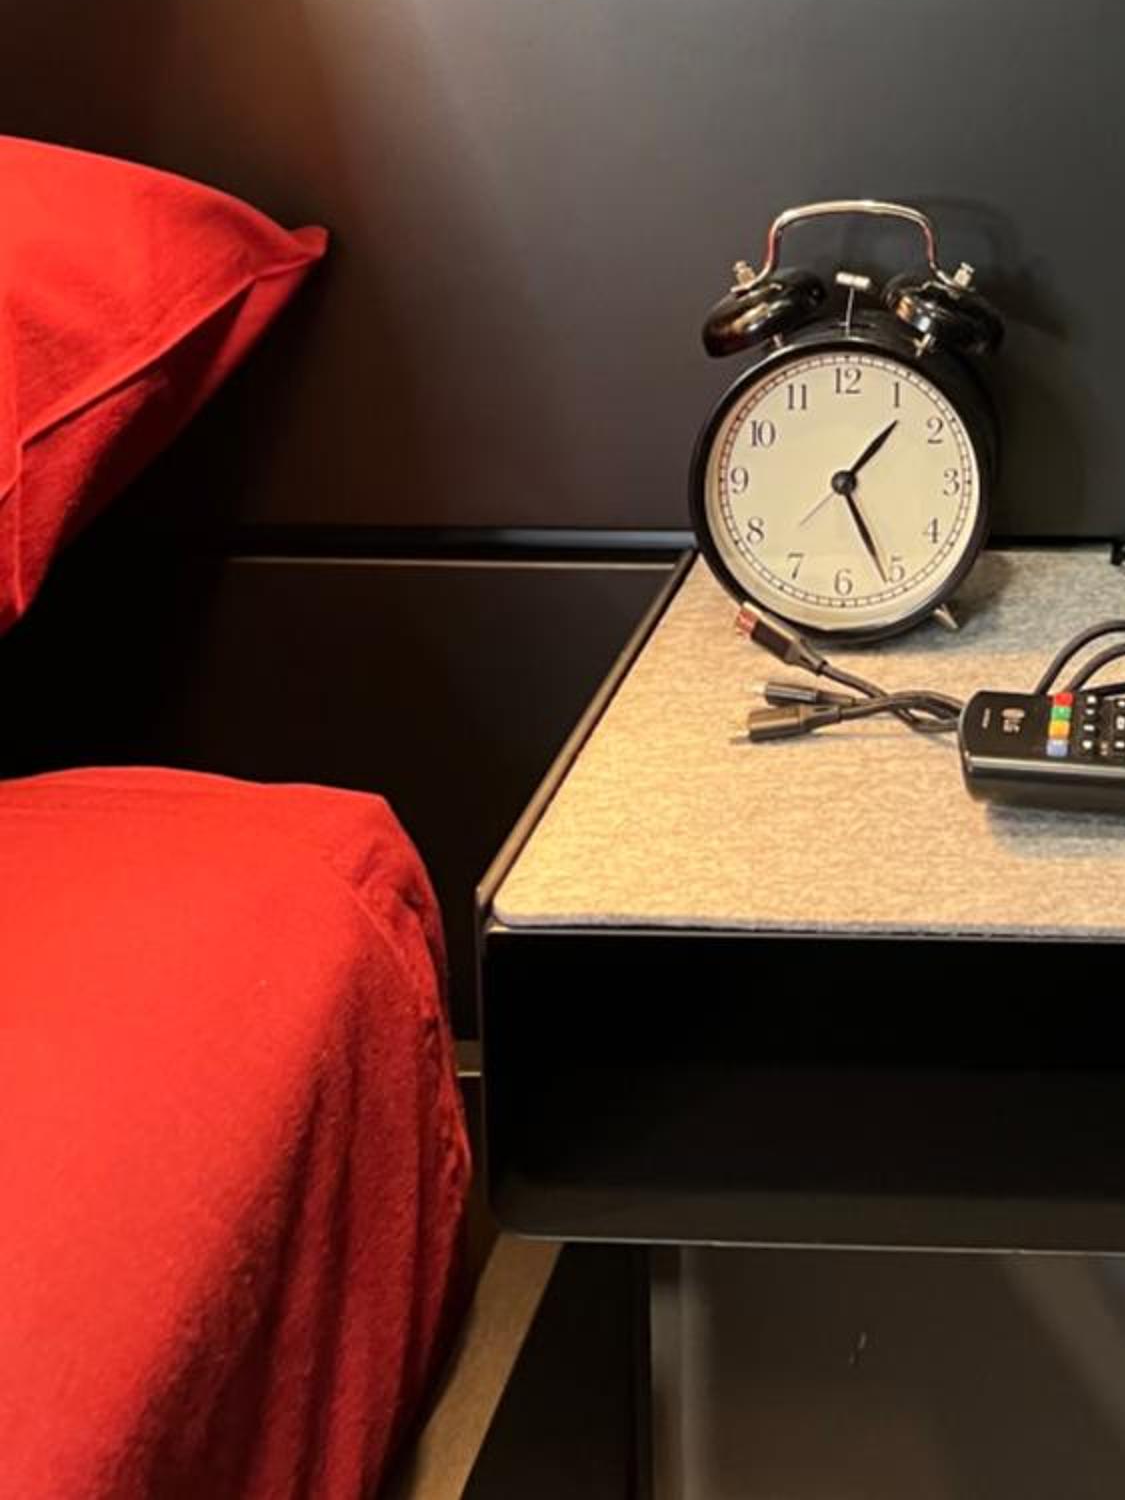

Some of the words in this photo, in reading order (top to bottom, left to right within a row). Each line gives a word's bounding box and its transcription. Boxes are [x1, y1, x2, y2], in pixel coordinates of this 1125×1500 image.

[834, 367, 862, 394] 12
[787, 383, 808, 411] 11
[893, 381, 901, 409] 1
[750, 420, 776, 448] 10
[926, 417, 944, 444] 2
[730, 467, 749, 494] 9
[943, 468, 960, 497] 3
[746, 517, 765, 544] 8
[923, 517, 941, 545] 4
[787, 553, 804, 581] 7
[889, 556, 905, 583] 5
[834, 569, 853, 596] 6
